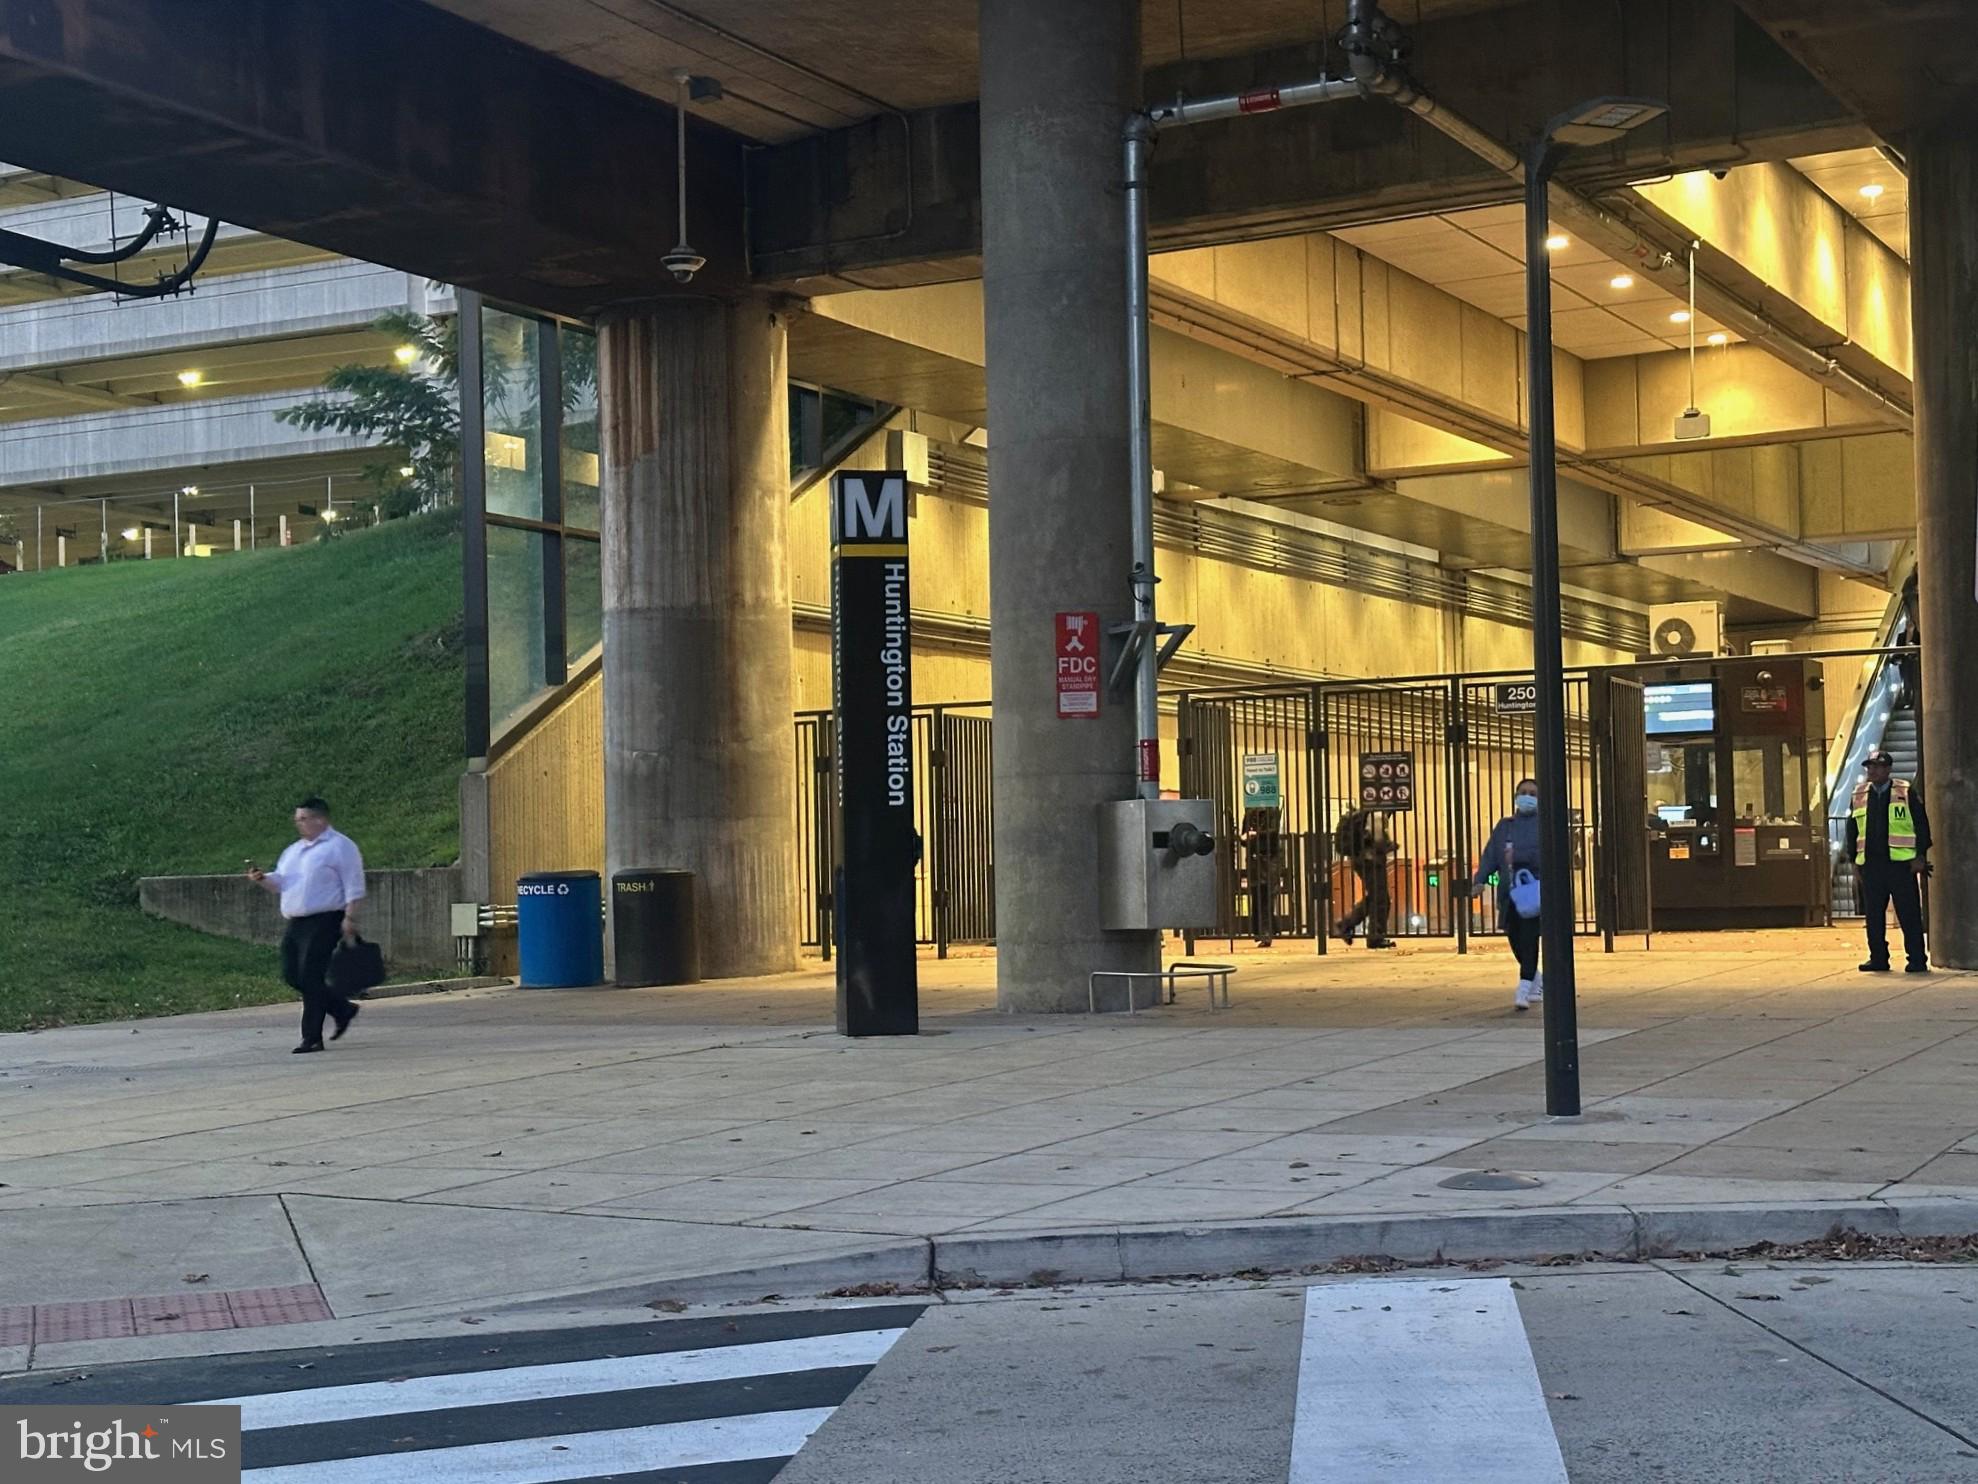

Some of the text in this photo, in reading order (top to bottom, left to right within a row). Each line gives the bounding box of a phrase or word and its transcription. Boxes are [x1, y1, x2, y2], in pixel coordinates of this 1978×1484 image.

[843, 478, 904, 538] M
[1059, 656, 1096, 673] FDC
[880, 563, 909, 806] Huntington Station
[1894, 806, 1906, 818] M
[616, 882, 646, 893] TRASH
